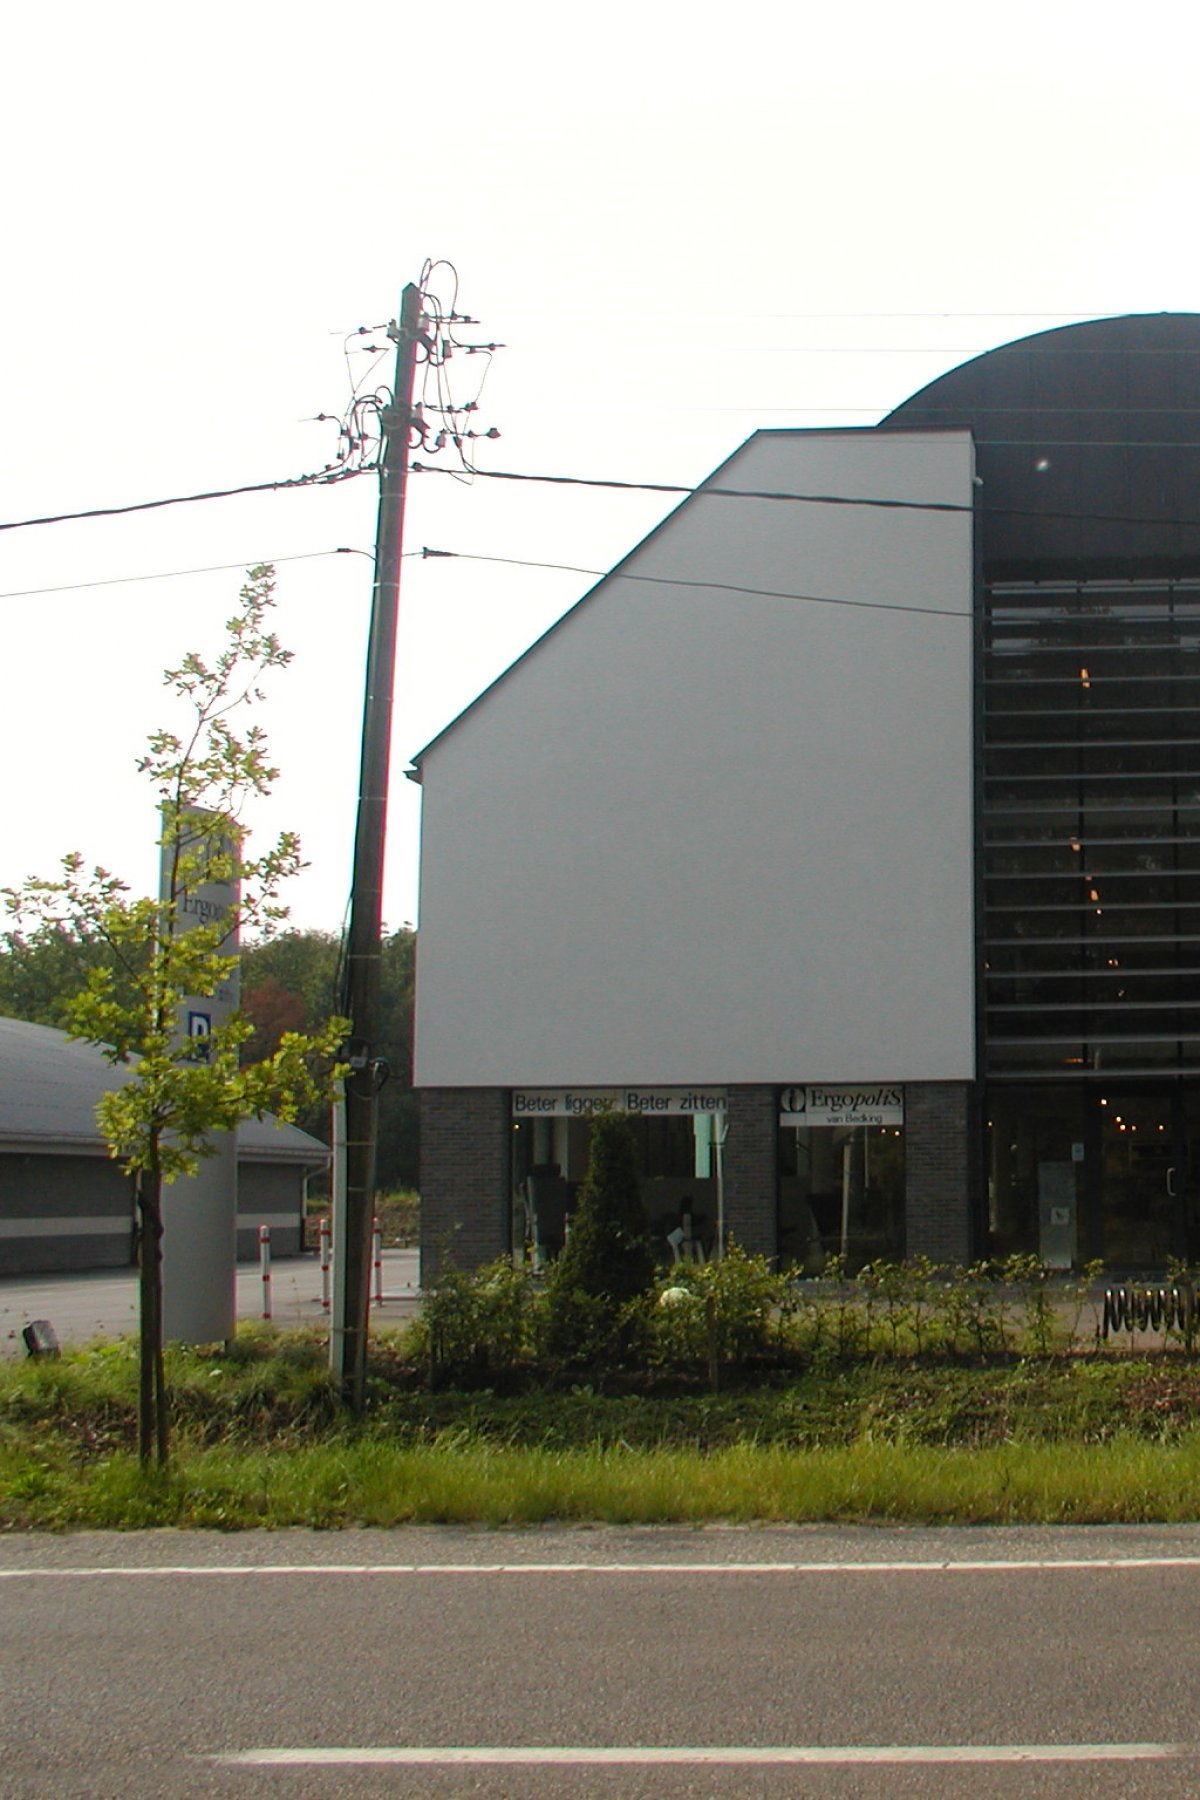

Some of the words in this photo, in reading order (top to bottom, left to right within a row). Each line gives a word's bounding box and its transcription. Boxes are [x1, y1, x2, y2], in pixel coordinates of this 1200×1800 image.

[515, 1094, 557, 1111] Beter
[627, 1092, 671, 1111] Beter
[679, 1092, 727, 1110] zitten
